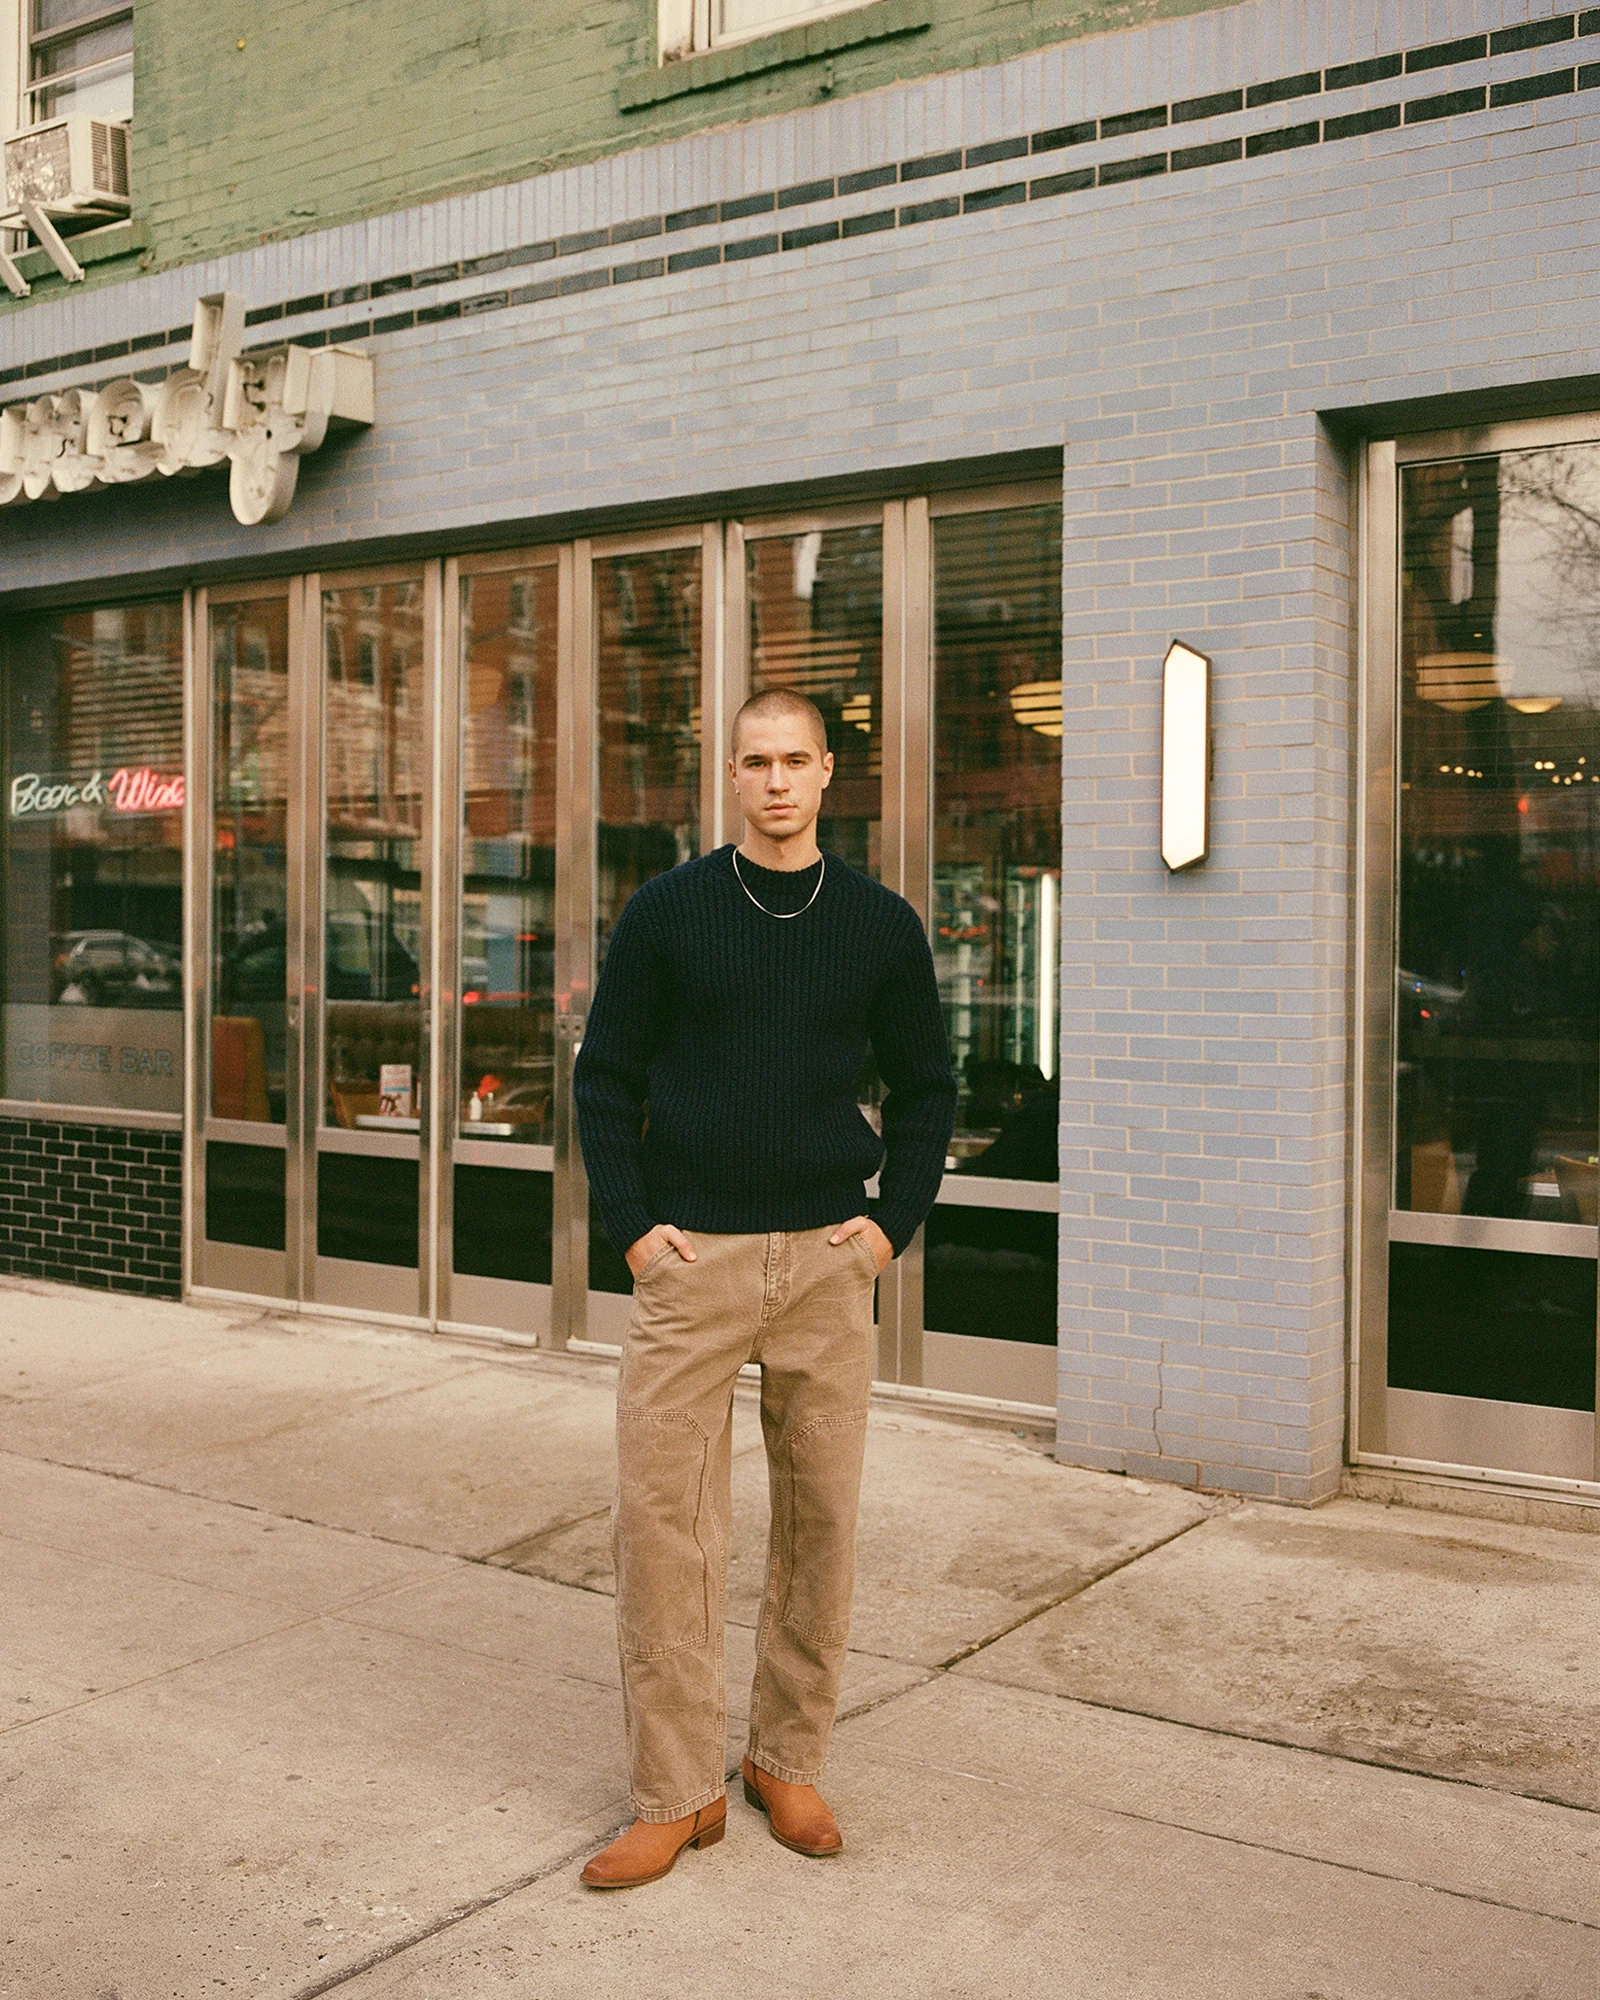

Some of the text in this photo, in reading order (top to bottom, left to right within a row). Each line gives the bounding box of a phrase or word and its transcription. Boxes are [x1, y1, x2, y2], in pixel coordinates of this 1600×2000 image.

[11, 773, 80, 816] Beer
[81, 771, 104, 804] &
[15, 1042, 173, 1077] COFFEE BAR
